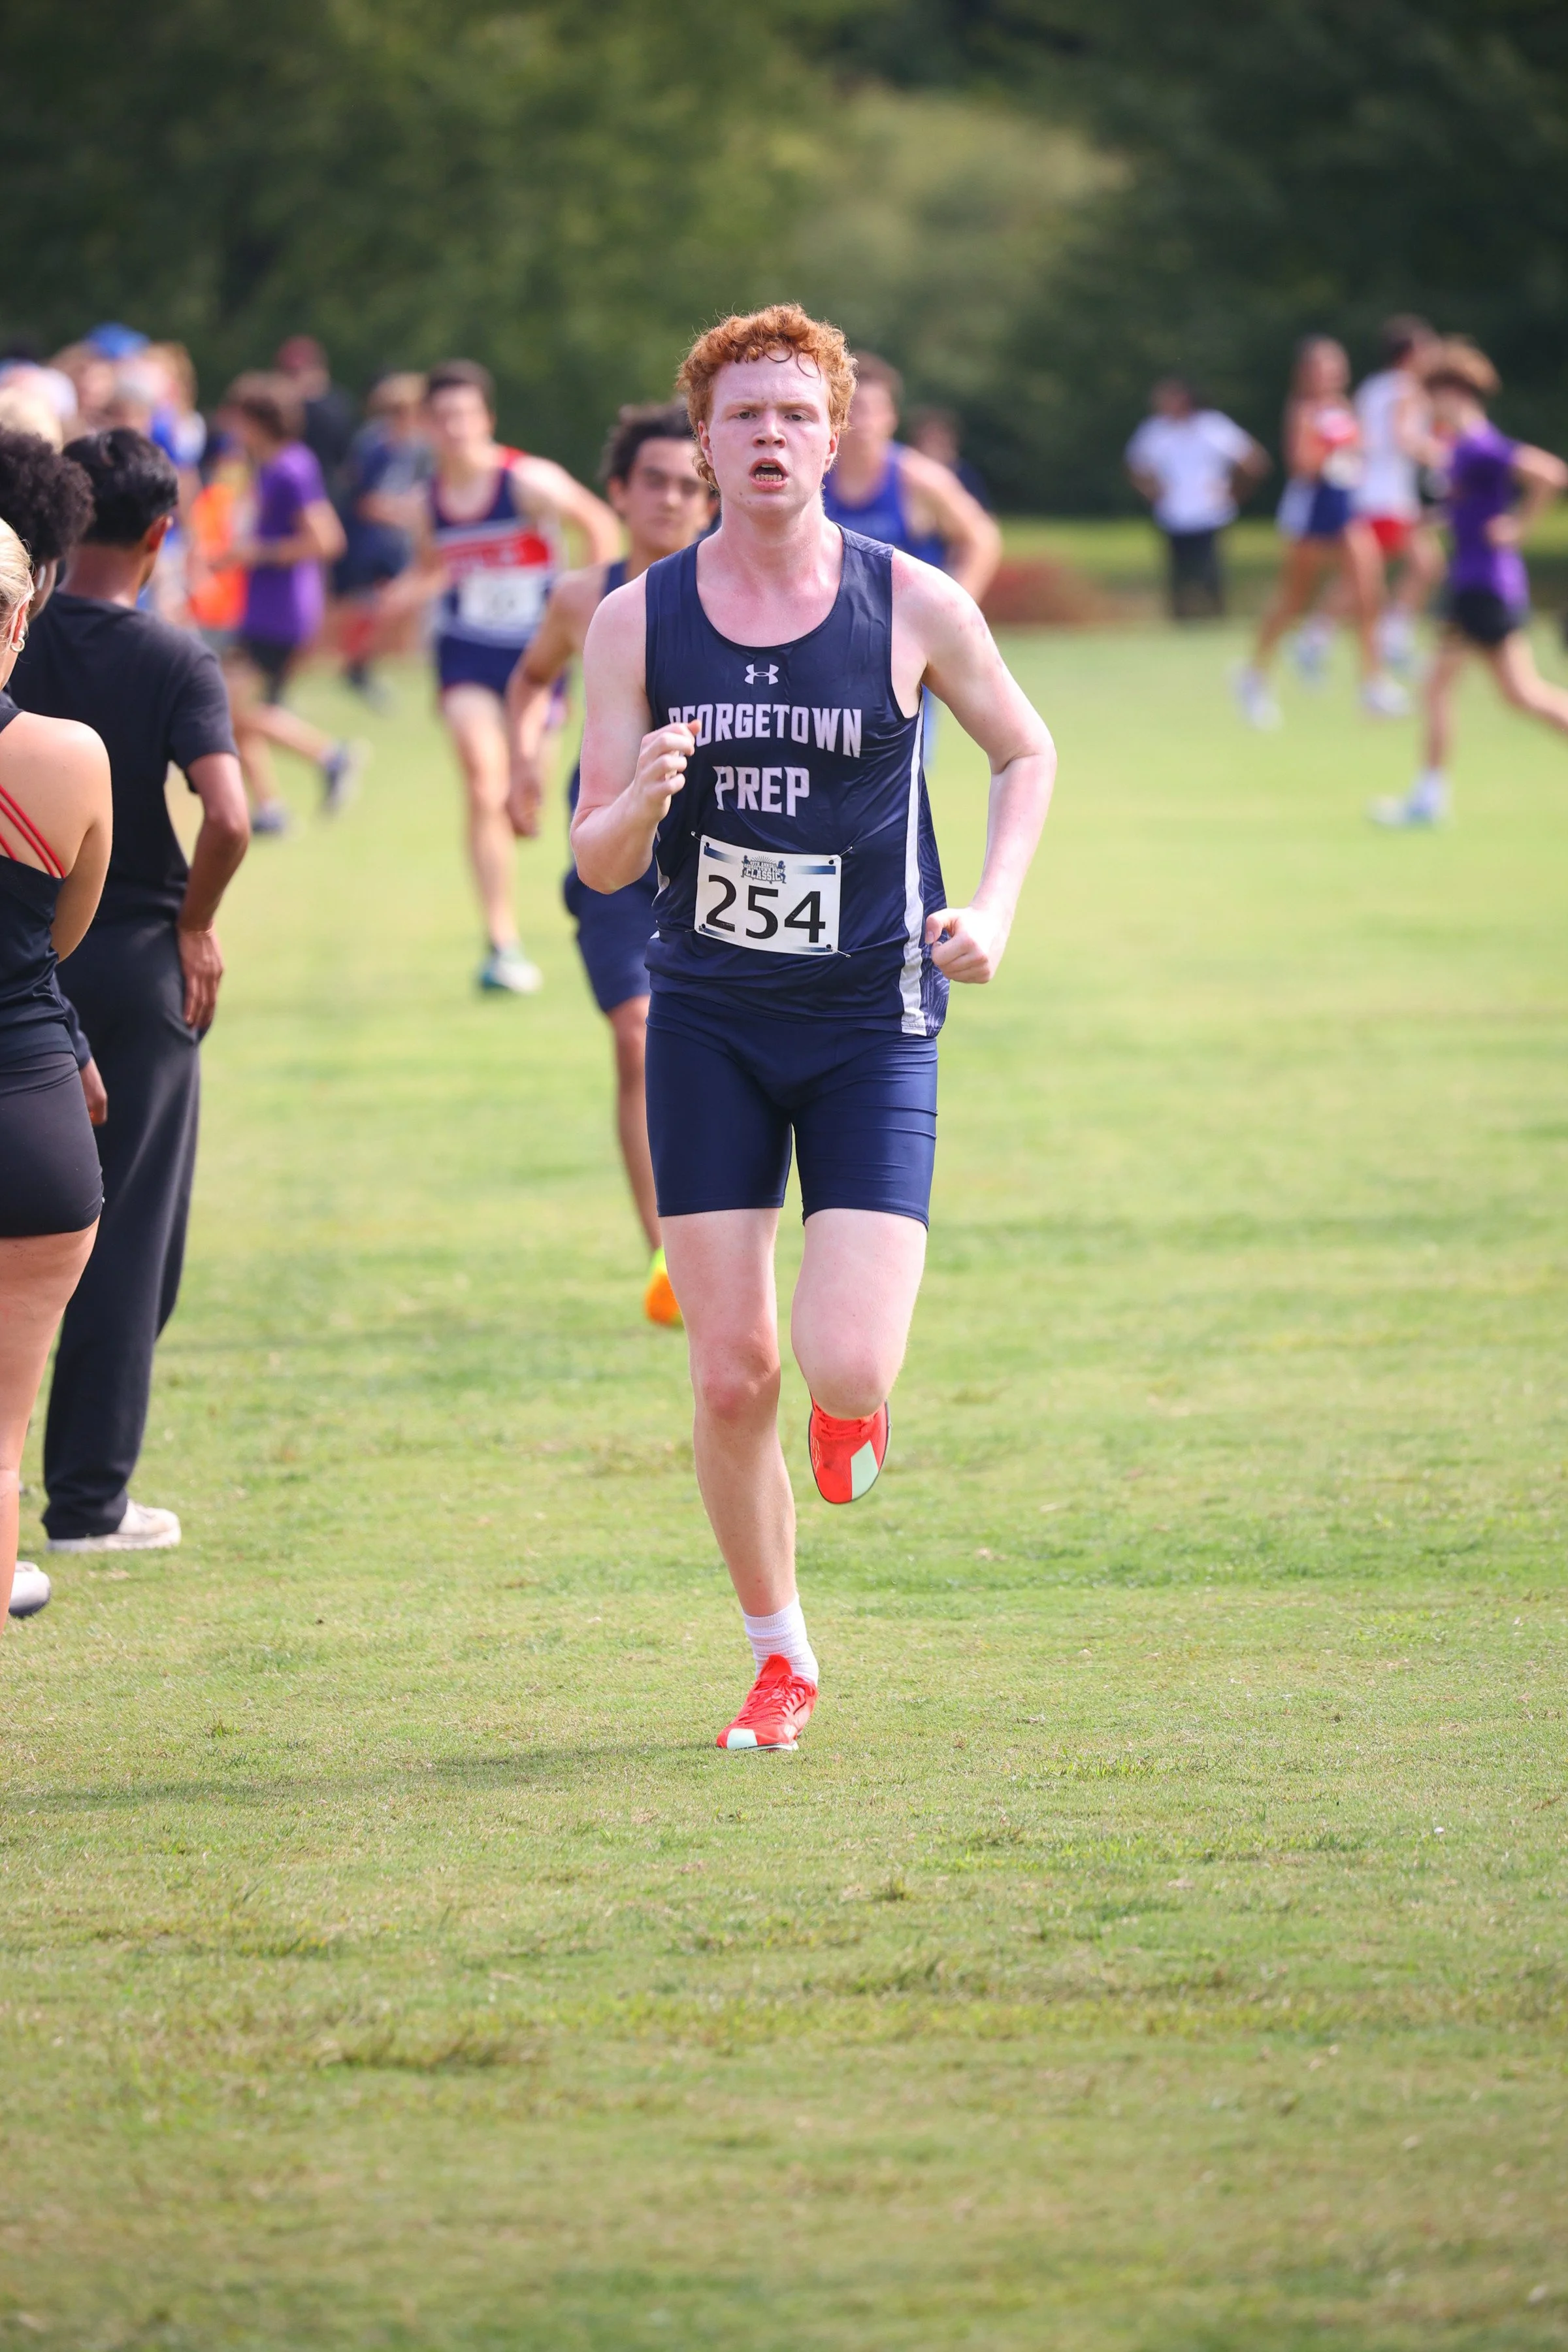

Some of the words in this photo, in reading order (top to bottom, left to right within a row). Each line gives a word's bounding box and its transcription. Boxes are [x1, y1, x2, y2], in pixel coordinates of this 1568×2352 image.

[712, 765, 809, 817] PREP
[745, 868, 781, 881] CLASSIC
[706, 875, 826, 943] 254
